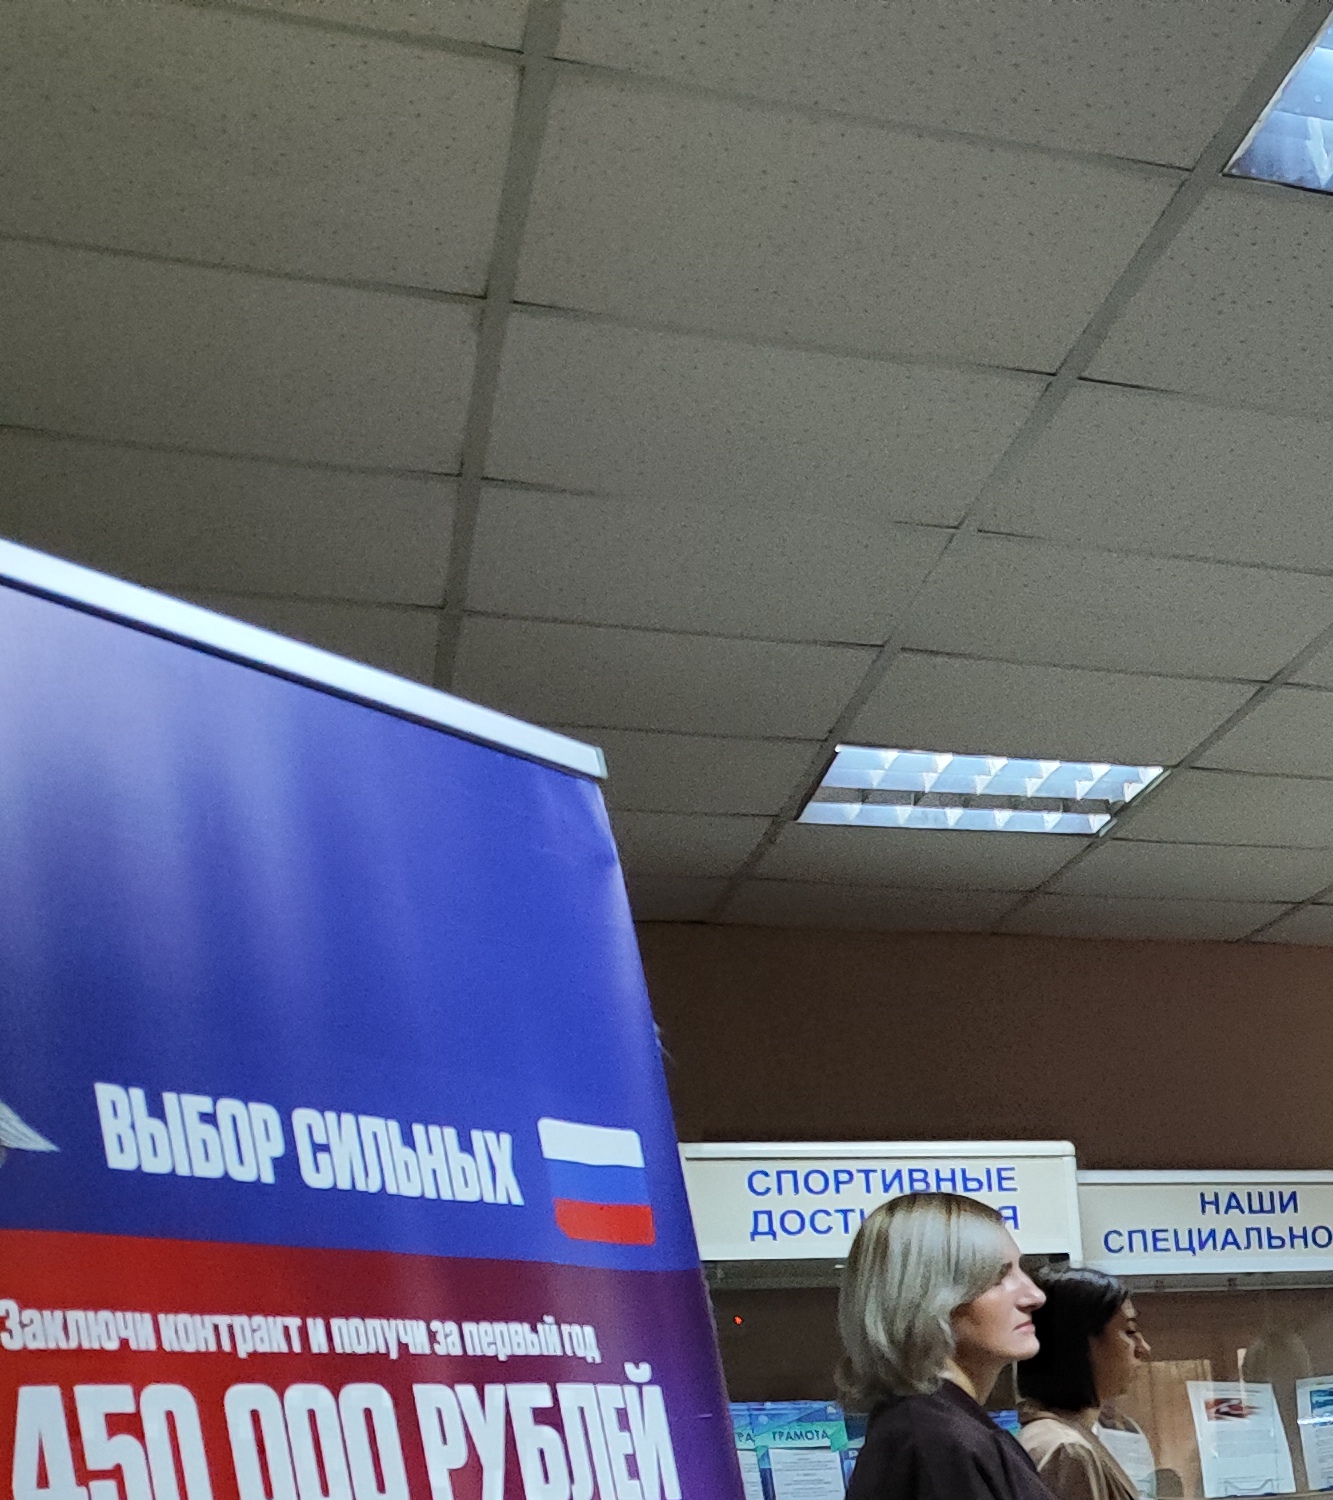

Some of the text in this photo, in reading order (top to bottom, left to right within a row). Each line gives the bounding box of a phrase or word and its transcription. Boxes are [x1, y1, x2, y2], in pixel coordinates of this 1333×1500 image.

[94, 1082, 525, 1206] ВЫБОР СИЛЬНЫХ
[747, 1167, 1018, 1196] СПОРТИВНЫЕ
[1200, 1191, 1299, 1216] НАШИ
[750, 1206, 1019, 1241] ДОСТЯ
[0, 1298, 601, 1364] Заключи контракт и получи за первый год
[771, 1429, 829, 1441] ГРАМОТА
